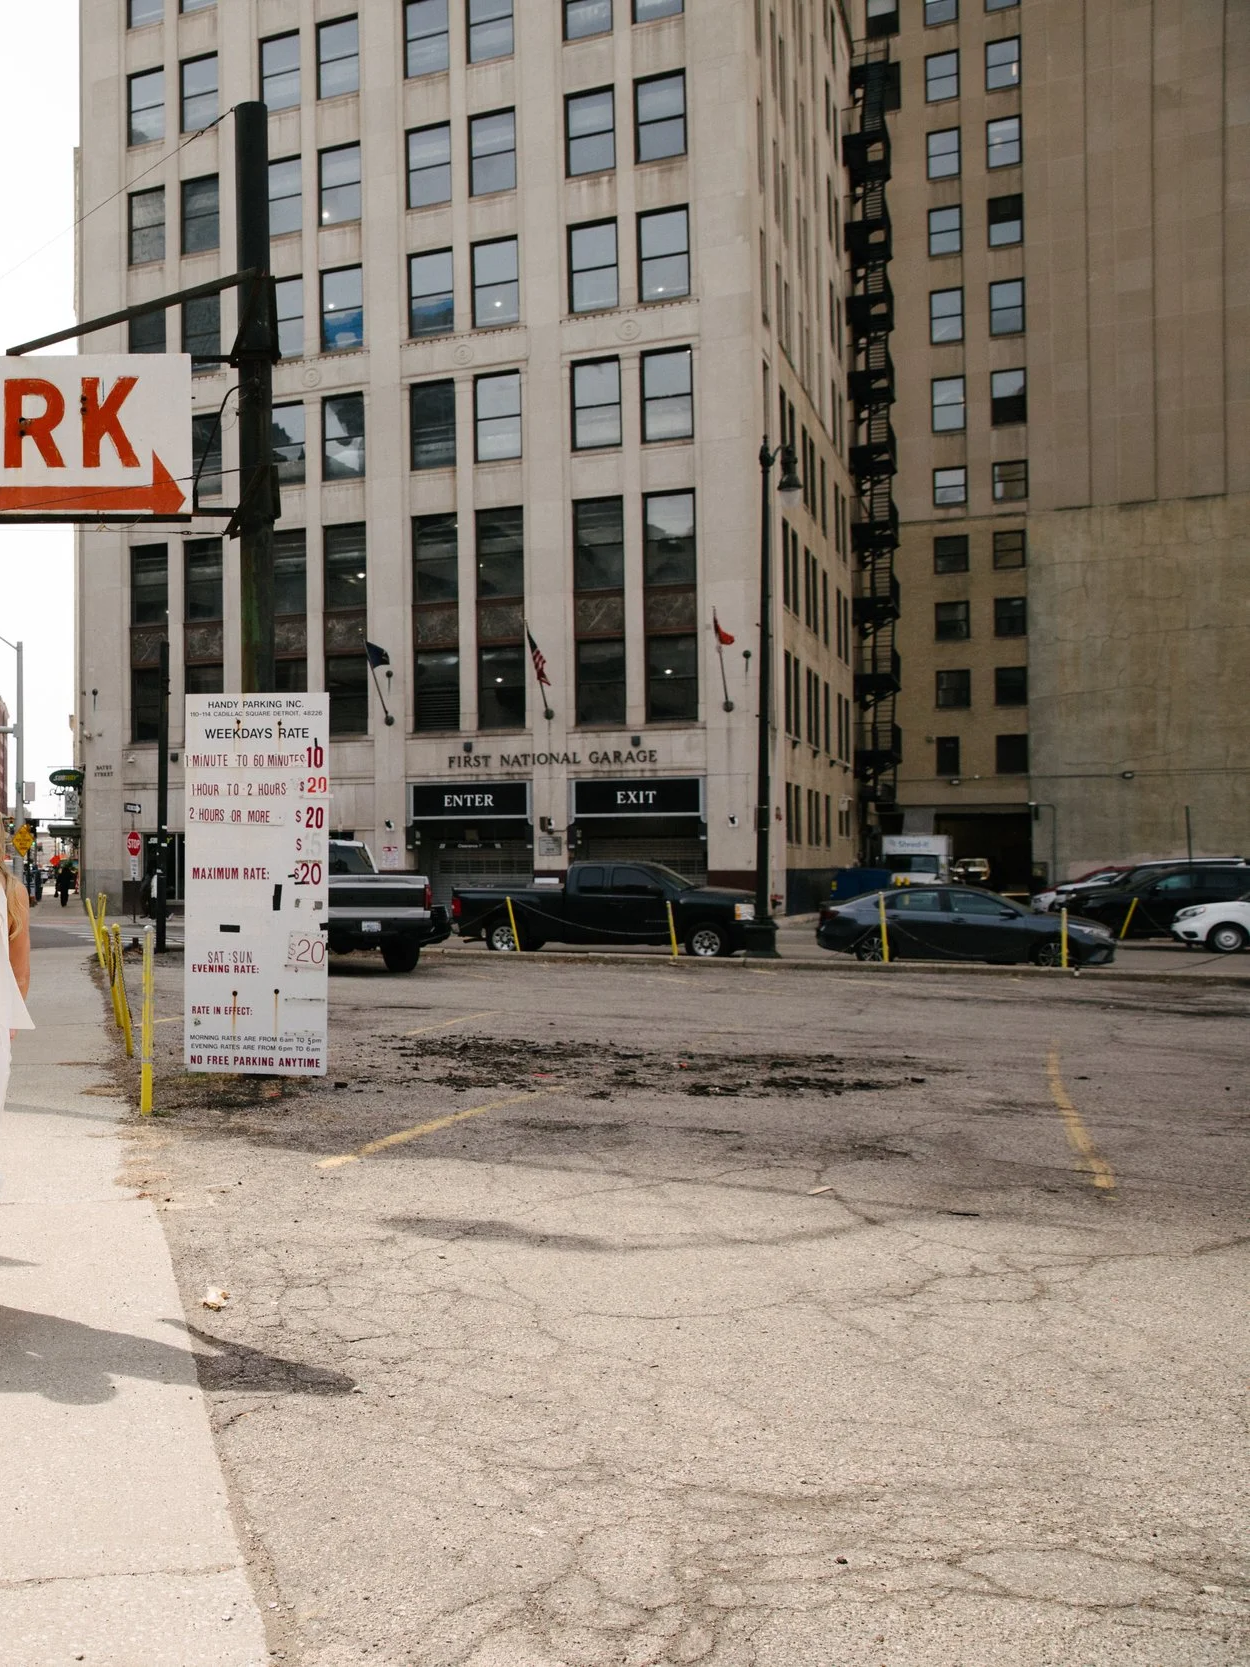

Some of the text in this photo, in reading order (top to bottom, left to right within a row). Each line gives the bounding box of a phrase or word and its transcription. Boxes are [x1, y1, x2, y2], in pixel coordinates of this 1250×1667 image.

[208, 700, 304, 709] HANDY PARKING INC.
[205, 728, 309, 739] WEEKDAYS RATE
[237, 754, 248, 767] TO
[253, 754, 264, 767] 60
[306, 746, 324, 768] 10
[448, 750, 657, 769] FIRST NATIONAL GARAGE
[227, 783, 239, 796] TO
[247, 783, 253, 796] 2
[258, 783, 287, 796] HOURS
[444, 794, 494, 807] ENTER
[616, 791, 657, 804] EXIT
[189, 807, 195, 820] 2
[199, 808, 225, 822] HOURS
[231, 810, 241, 823] OR
[248, 810, 270, 823] MORE
[128, 838, 141, 849] STOP
[192, 867, 239, 880] MAXIMUM
[243, 867, 270, 880] RATE:
[207, 950, 225, 964] SAT
[192, 964, 260, 974] EVENING RATE:
[191, 1005, 253, 1016] RATE IN EFFECT:
[190, 1055, 321, 1068] NO FREE PARKING ANYTIME
